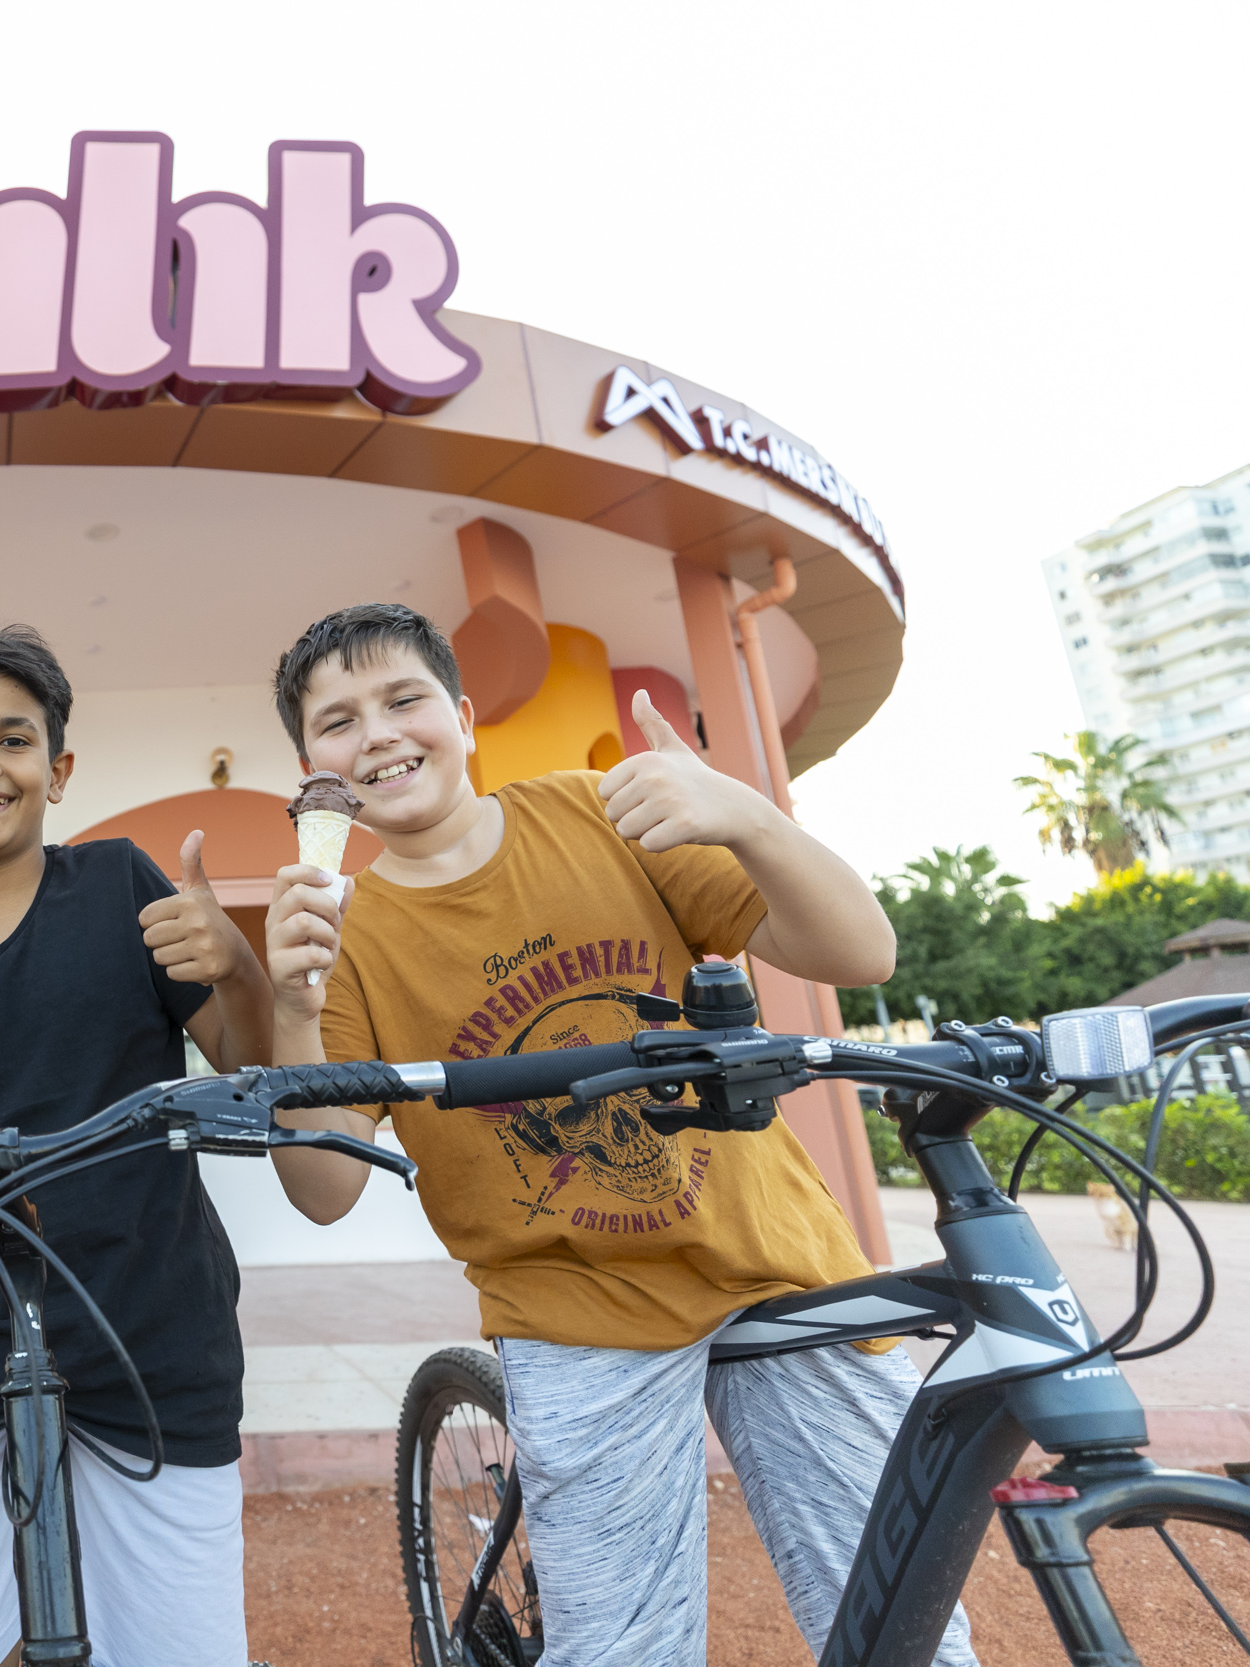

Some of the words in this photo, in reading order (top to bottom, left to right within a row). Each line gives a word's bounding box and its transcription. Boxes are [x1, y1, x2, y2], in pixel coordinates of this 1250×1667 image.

[483, 933, 555, 986] Boston
[449, 938, 652, 1060] EXPERIMENTAL
[550, 1025, 580, 1045] Since
[722, 1037, 768, 1047] SHIMANO
[803, 1034, 898, 1057] CAMARO
[494, 1127, 531, 1189] LOFT
[570, 1207, 672, 1234] ORIGINAL
[673, 1147, 712, 1220] APPAREL
